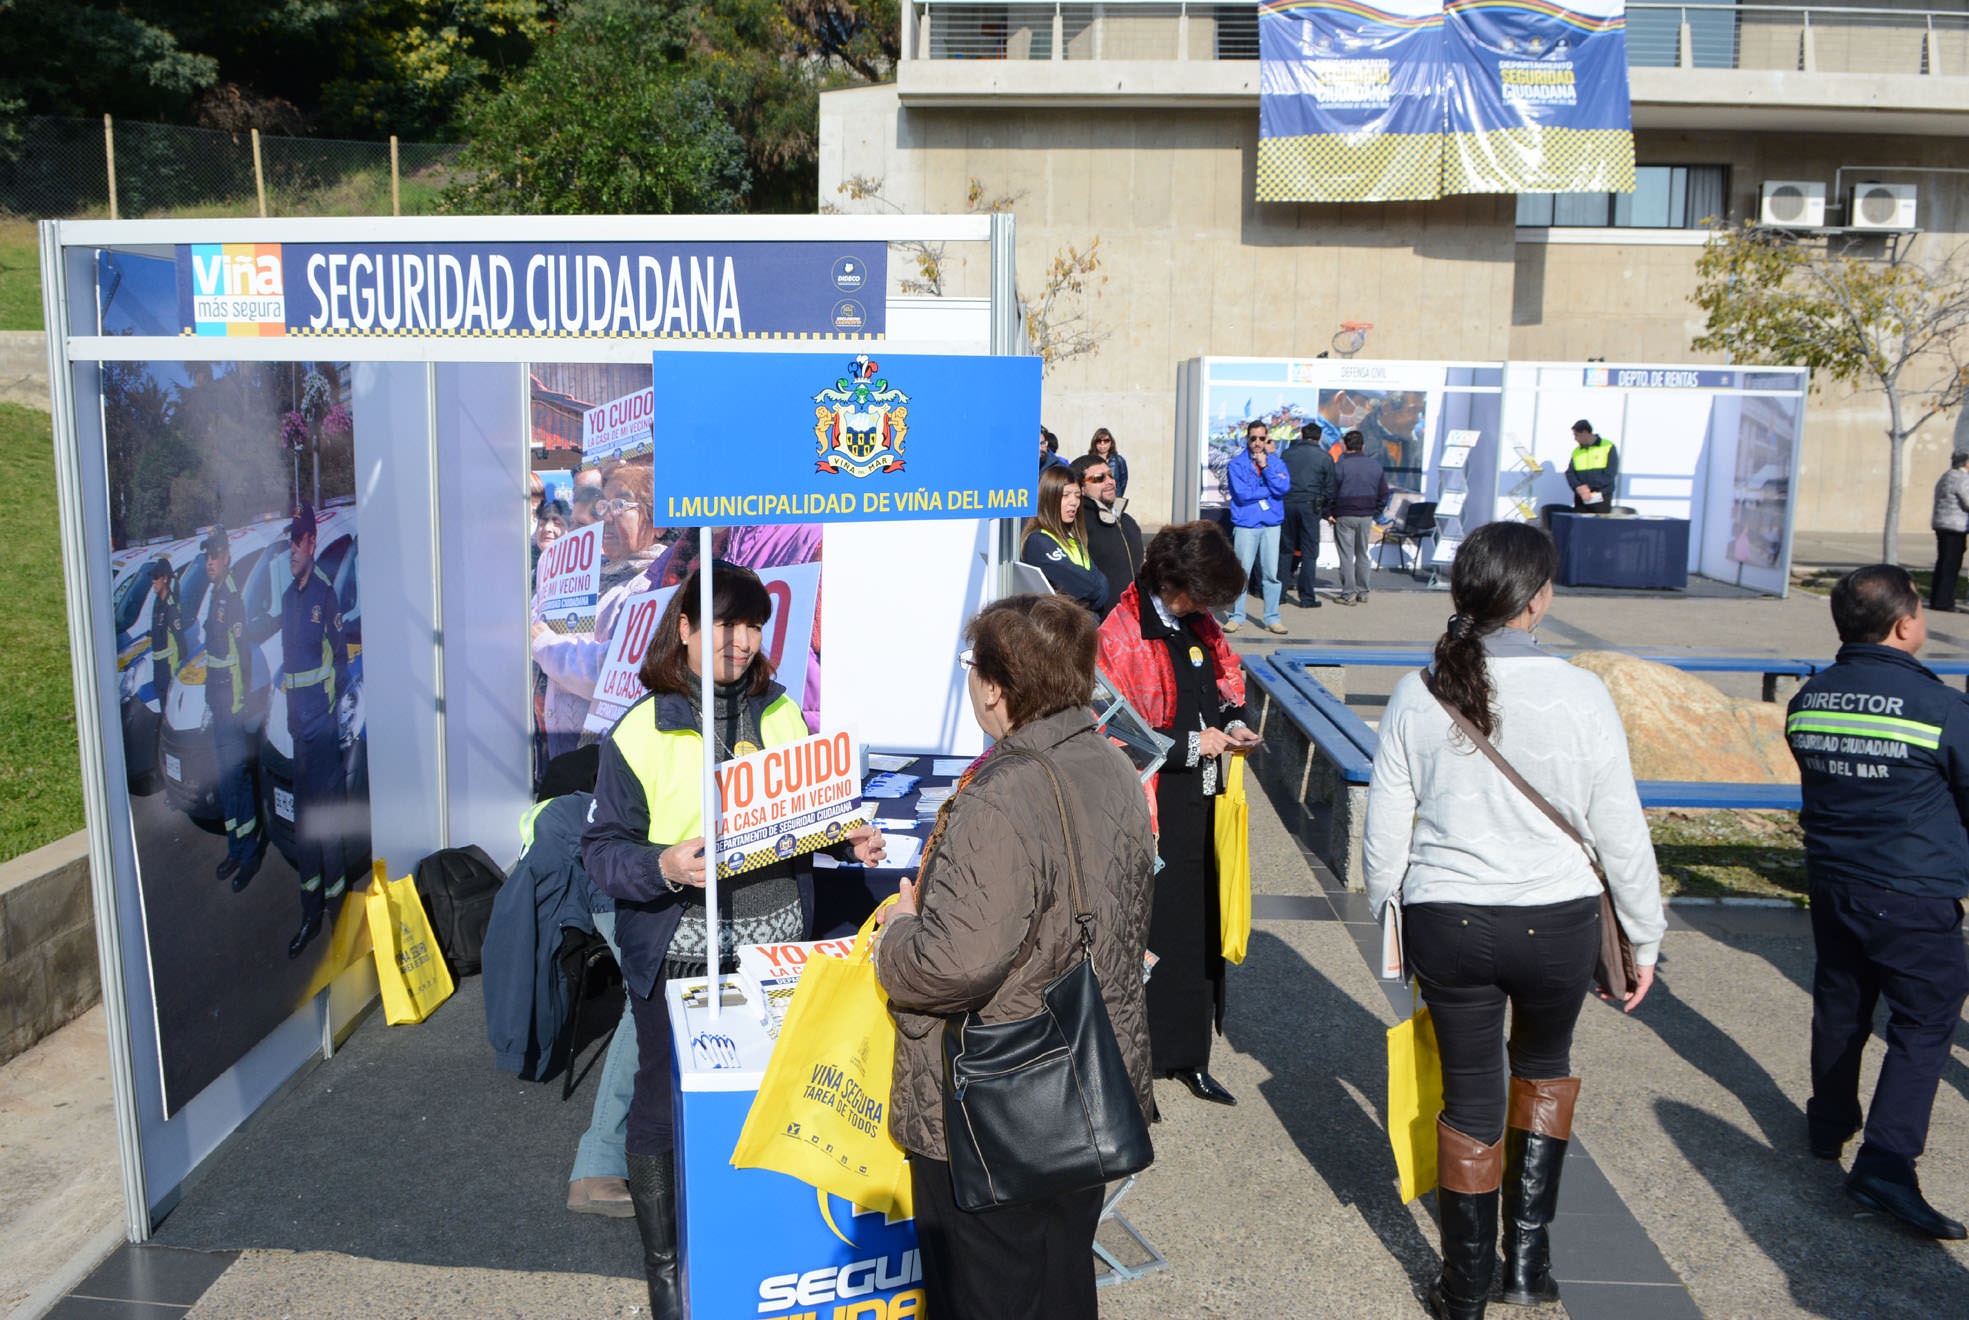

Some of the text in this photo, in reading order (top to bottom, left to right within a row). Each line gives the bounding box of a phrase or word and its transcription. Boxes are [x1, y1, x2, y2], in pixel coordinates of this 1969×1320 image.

[1500, 69, 1576, 85] SEGURIDAD
[1502, 83, 1577, 99] CIUDADANA
[307, 253, 742, 332] SEGURIDAD CIUDADANA
[198, 298, 281, 321] más segura
[1618, 370, 1649, 387] DEPTO.
[1651, 371, 1663, 387] DE
[1664, 371, 1699, 388] RENTAS
[589, 391, 654, 435] YO CUIDO
[868, 457, 888, 472] MAR
[669, 487, 1029, 517] I.MUNICIPALIDAD DE VIÑA DEL MAR
[543, 531, 595, 583] CUIDO
[560, 574, 591, 594] VECINO
[617, 599, 657, 665] YO
[603, 669, 643, 701] LA CASA
[1801, 692, 1904, 715] DIRECTOR
[1840, 737, 1909, 759] CIUDADANA
[715, 731, 851, 813] YO CUIDO
[1829, 760, 1853, 776] DEL
[1857, 763, 1890, 778] MAR
[734, 806, 767, 832] CASA
[771, 799, 787, 821] DE
[791, 795, 806, 815] MI
[810, 779, 852, 807] VECINO
[716, 828, 768, 852] DEPARTAMENTO
[769, 826, 778, 836] DE
[779, 813, 816, 835] SEGURIDAD
[816, 800, 853, 820] CIUDADANA
[755, 945, 808, 967] YO
[769, 968, 790, 978] LA
[811, 1063, 844, 1092] VIÑA
[841, 1078, 883, 1124] SEGURA
[803, 1085, 878, 1139] TAREA DE TODOS
